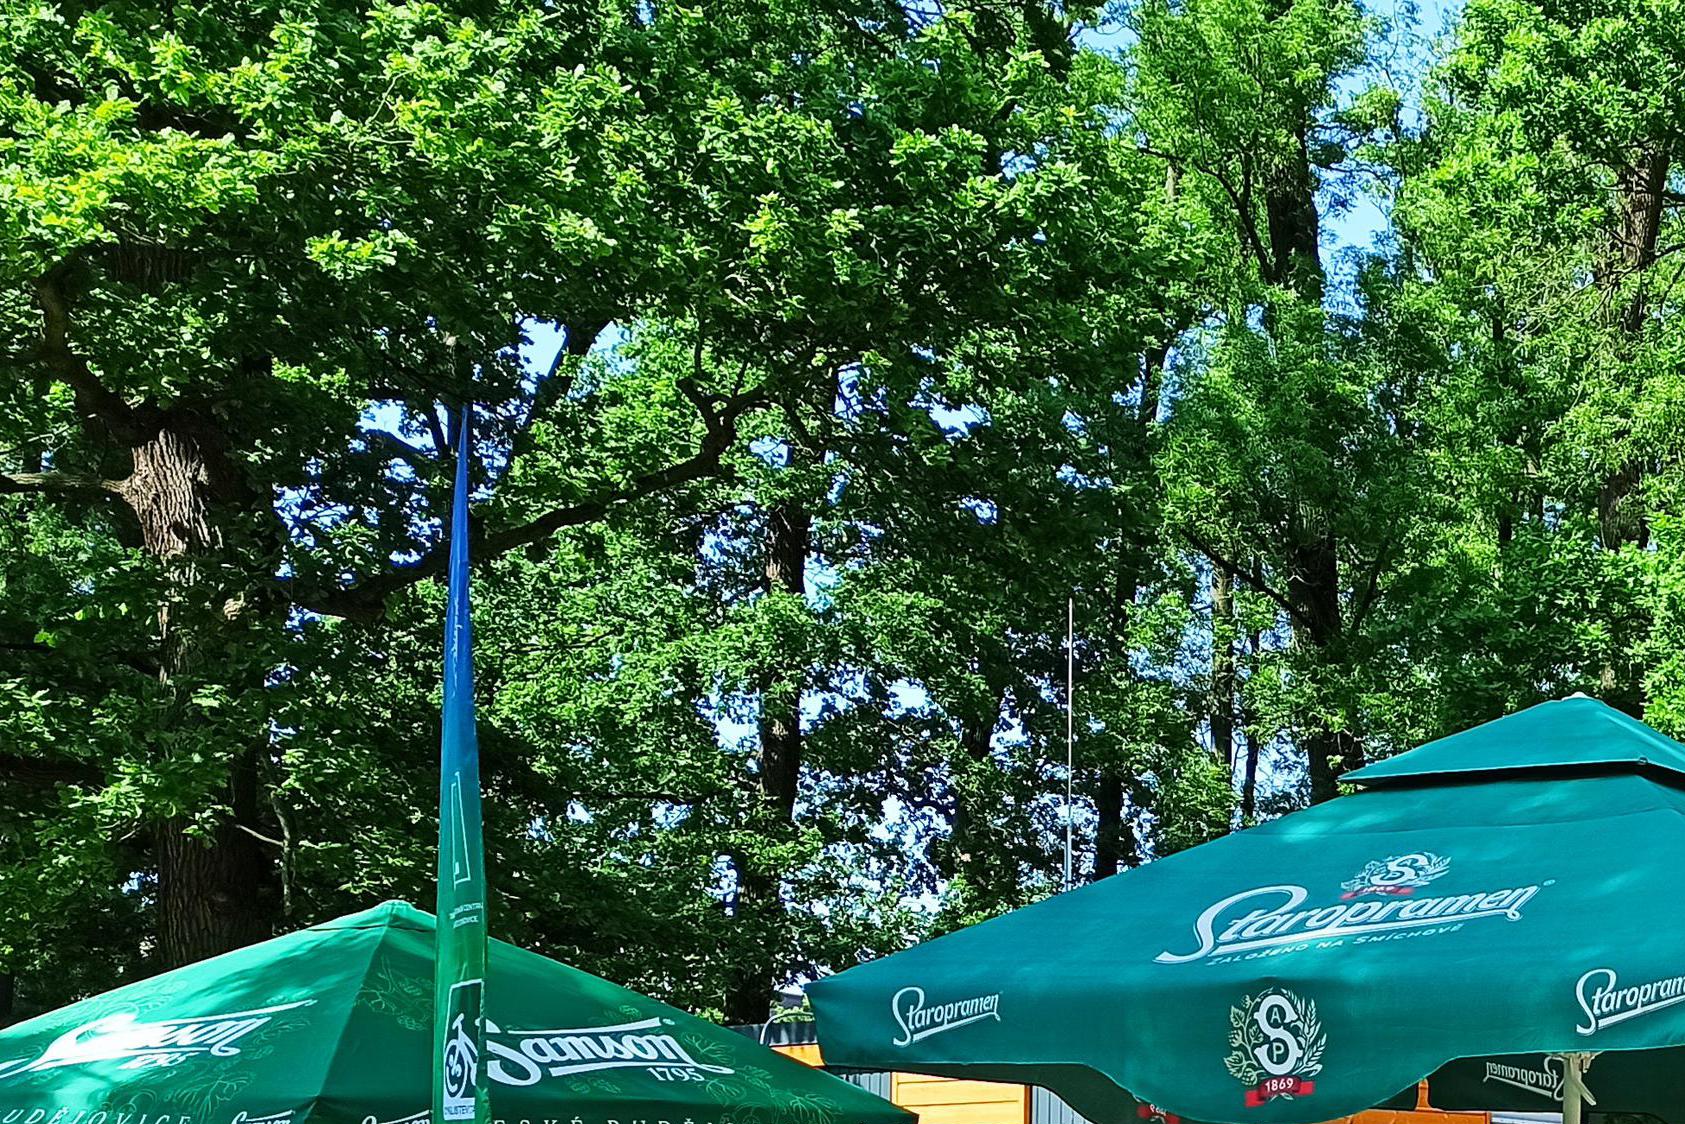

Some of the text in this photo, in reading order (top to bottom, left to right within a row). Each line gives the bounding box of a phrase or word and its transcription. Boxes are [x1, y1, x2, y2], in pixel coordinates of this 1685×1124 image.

[1152, 885, 1539, 965] Staropramen
[892, 986, 1001, 1046] Staropramen
[486, 1017, 735, 1086] Samson
[646, 1066, 706, 1082] 1795
[1265, 1077, 1295, 1093] 1869
